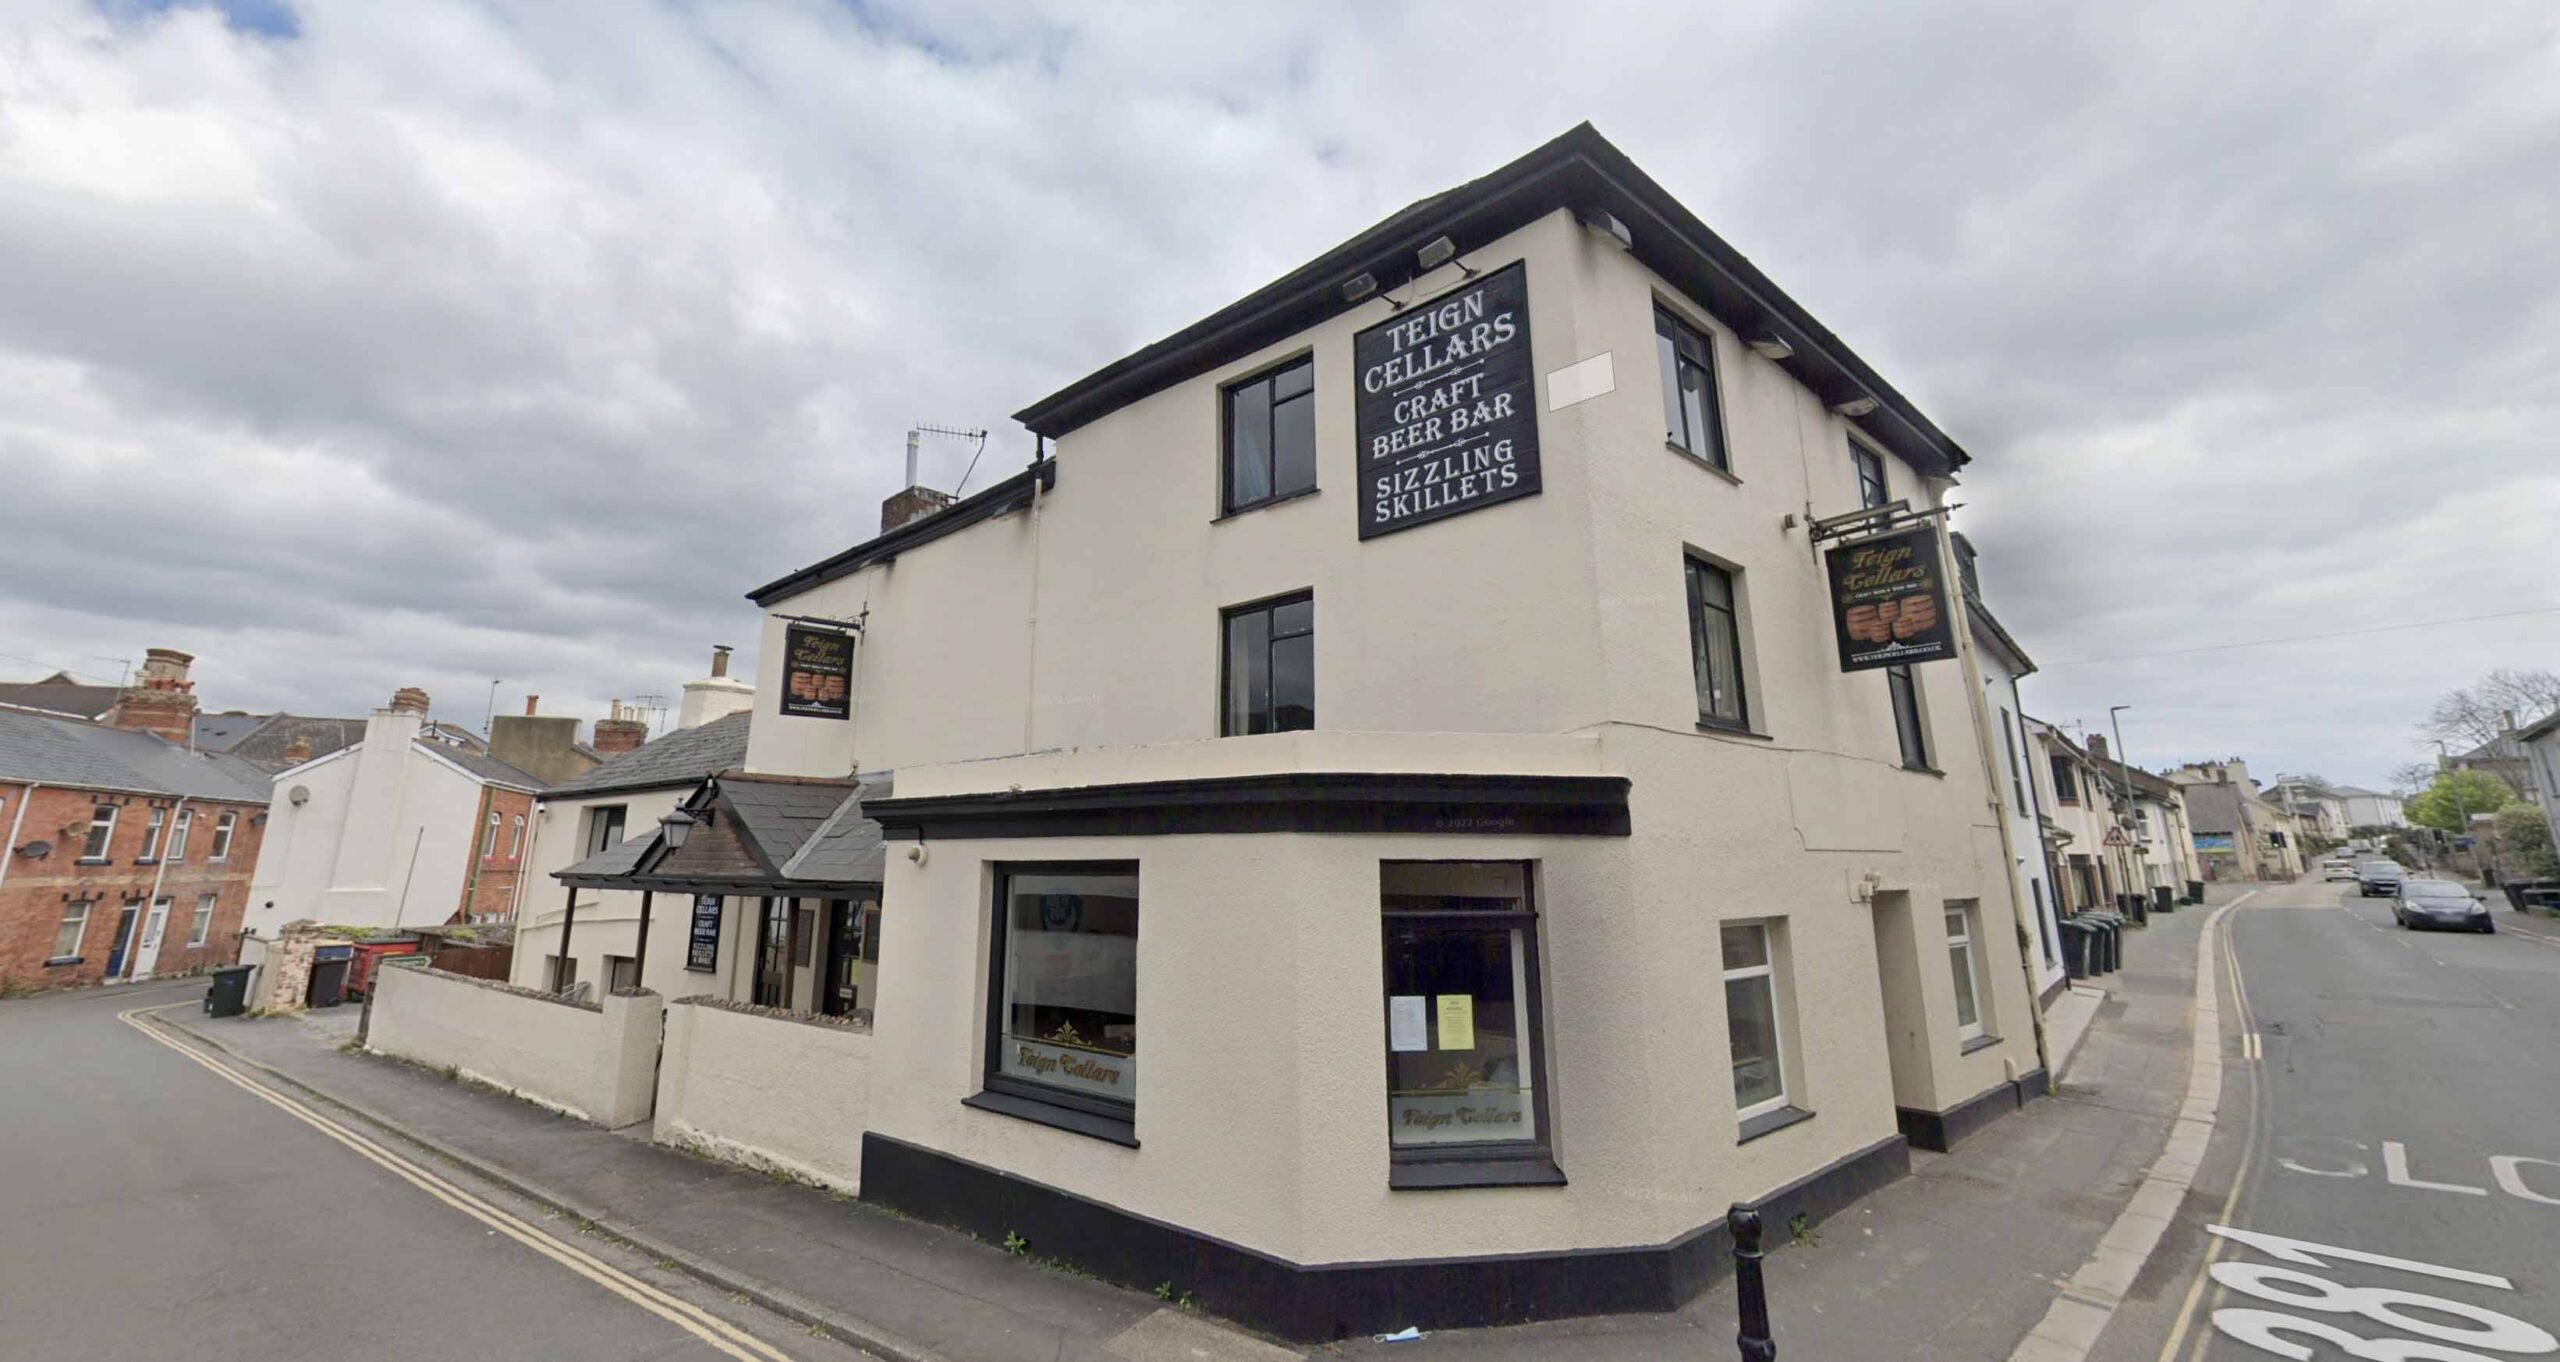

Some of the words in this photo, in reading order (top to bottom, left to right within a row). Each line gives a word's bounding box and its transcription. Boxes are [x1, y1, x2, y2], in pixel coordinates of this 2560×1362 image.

[1386, 290, 1484, 353] TEIGN
[1364, 312, 1516, 393] CELLARS
[1372, 418, 1445, 460] BEER
[1450, 392, 1516, 434] BAR
[1394, 373, 1485, 424] CRAFT
[1375, 463, 1519, 523] SKILLETS
[1376, 439, 1514, 499] SIZZLING
[1843, 564, 1928, 589] Cellars
[1852, 547, 1912, 567] Teign
[1018, 1046, 1058, 1074] Teign
[1059, 1053, 1121, 1084] Cellars
[1402, 1108, 1453, 1131] Teign
[1455, 1106, 1522, 1125] Cellars
